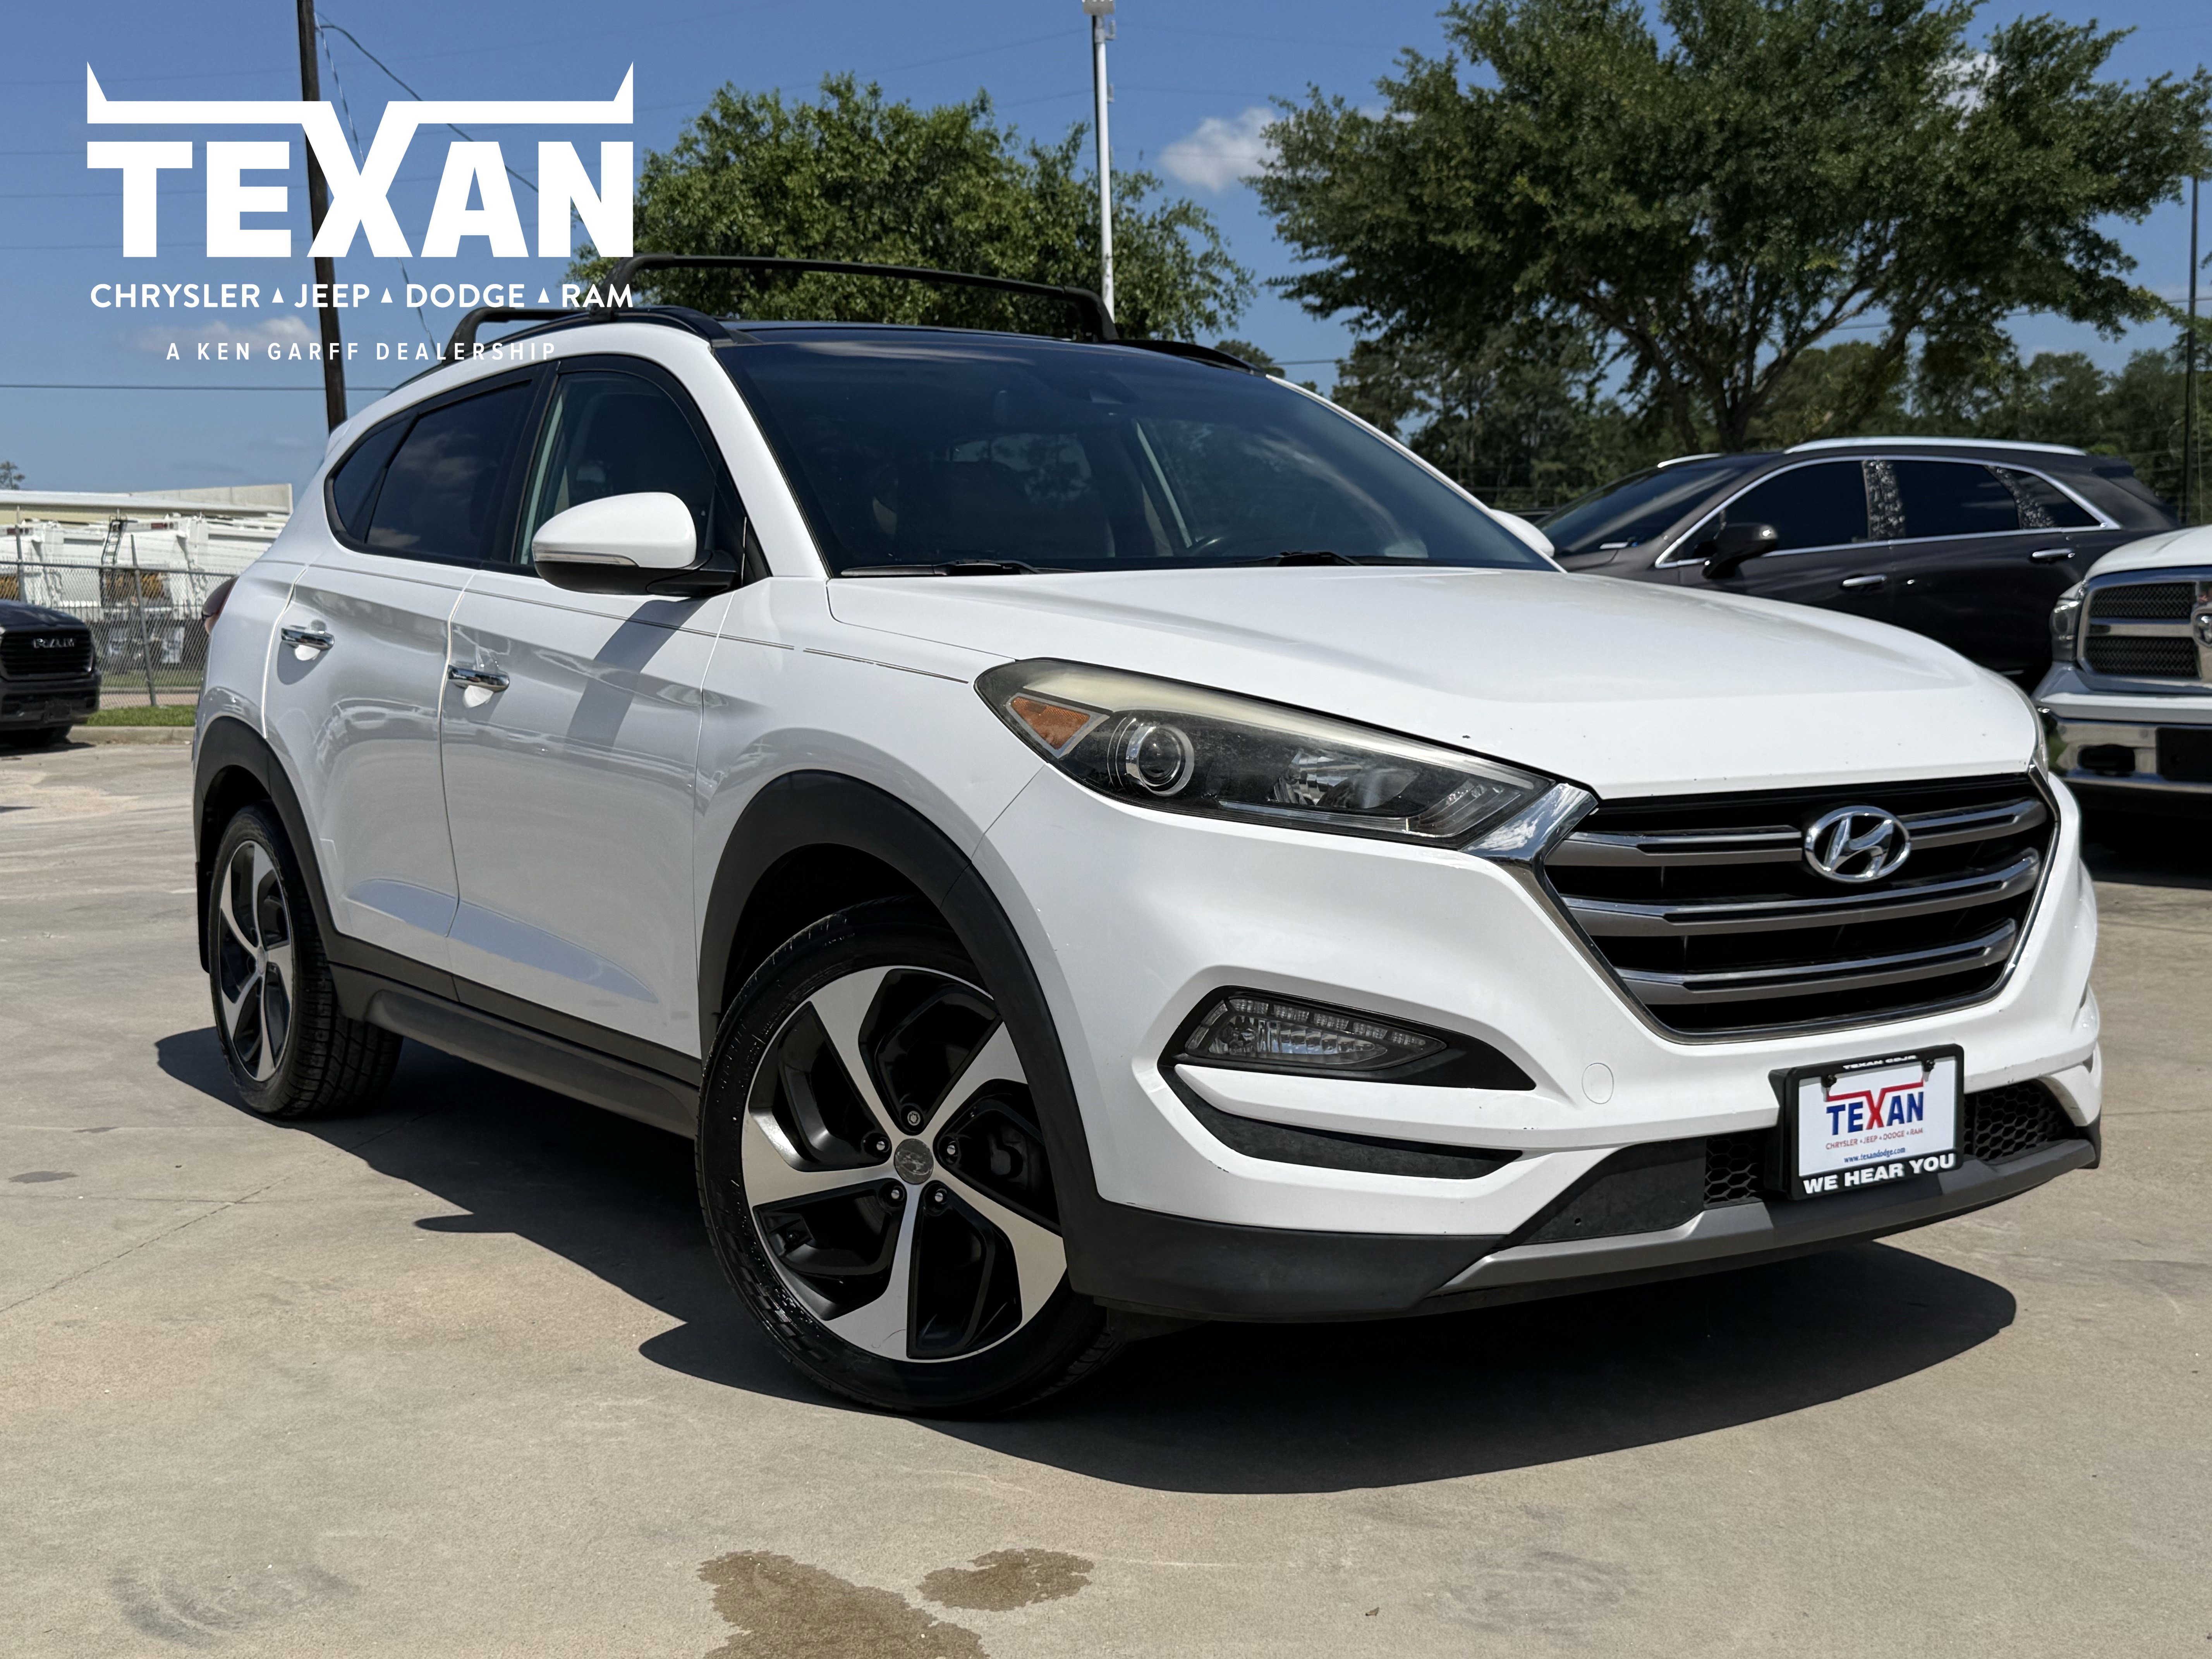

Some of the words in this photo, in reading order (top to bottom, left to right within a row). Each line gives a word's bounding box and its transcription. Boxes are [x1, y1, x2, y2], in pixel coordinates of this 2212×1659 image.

[33, 638, 75, 649] RAM
[1843, 1060, 1884, 1070] TEXAN
[1826, 1087, 1924, 1135] TEXAN
[1826, 1138, 1858, 1150] CHRYSLER
[1863, 1135, 1878, 1144] JEEP
[1883, 1130, 1905, 1140] DODGE
[1844, 1147, 1906, 1163] www.texandodge.com
[1803, 1174, 1838, 1194] WE
[1844, 1163, 1905, 1187] HEAR
[1909, 1153, 1956, 1174] YOU
